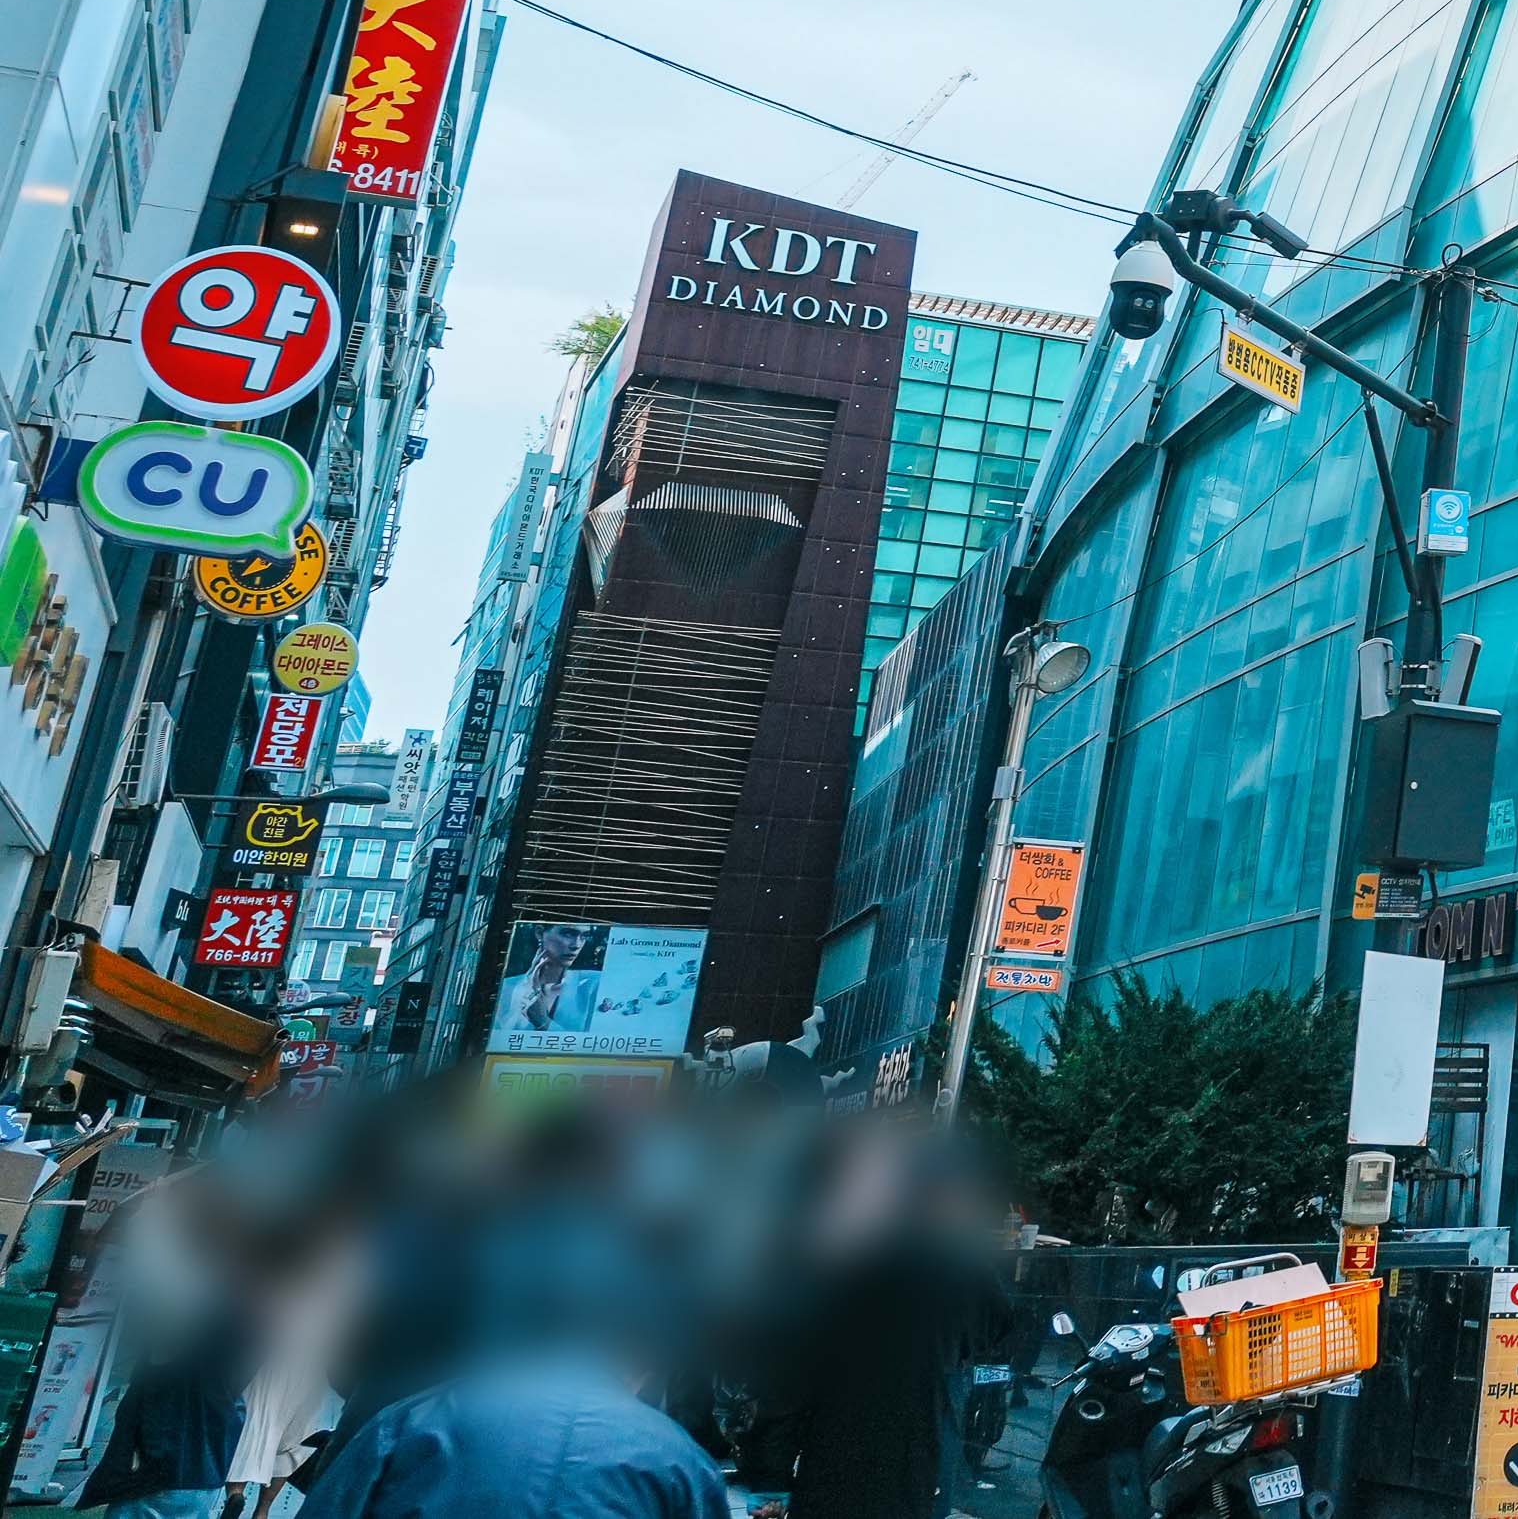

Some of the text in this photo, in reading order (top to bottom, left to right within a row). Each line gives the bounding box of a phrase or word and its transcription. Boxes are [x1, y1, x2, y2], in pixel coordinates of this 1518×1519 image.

[705, 217, 876, 284] KDT
[667, 275, 888, 330] DIAMOND
[170, 267, 319, 392] 약
[127, 451, 269, 516] CU
[509, 476, 546, 571] 한국다이아몬드거래소
[208, 575, 304, 611] COFFEE
[292, 633, 348, 652] 그레이스
[278, 655, 348, 675] 다이아몬드
[264, 695, 309, 769] 전당포
[404, 748, 426, 773] 씨앗
[446, 781, 474, 830] 부동산
[266, 816, 288, 827] 야간
[263, 828, 284, 838] 진료
[233, 850, 308, 866] 이안한의원
[1020, 853, 1055, 865] 더쌍화
[1035, 867, 1071, 881] COFFEE
[202, 908, 288, 949] 大陸
[1005, 922, 1065, 935] 피카디리 2F
[1482, 893, 1505, 957] N
[611, 938, 628, 946] Lab
[206, 950, 273, 962] 766-8411
[509, 1034, 663, 1053] 랩 그로운 다이아몬드
[1266, 1479, 1297, 1497] 1139
